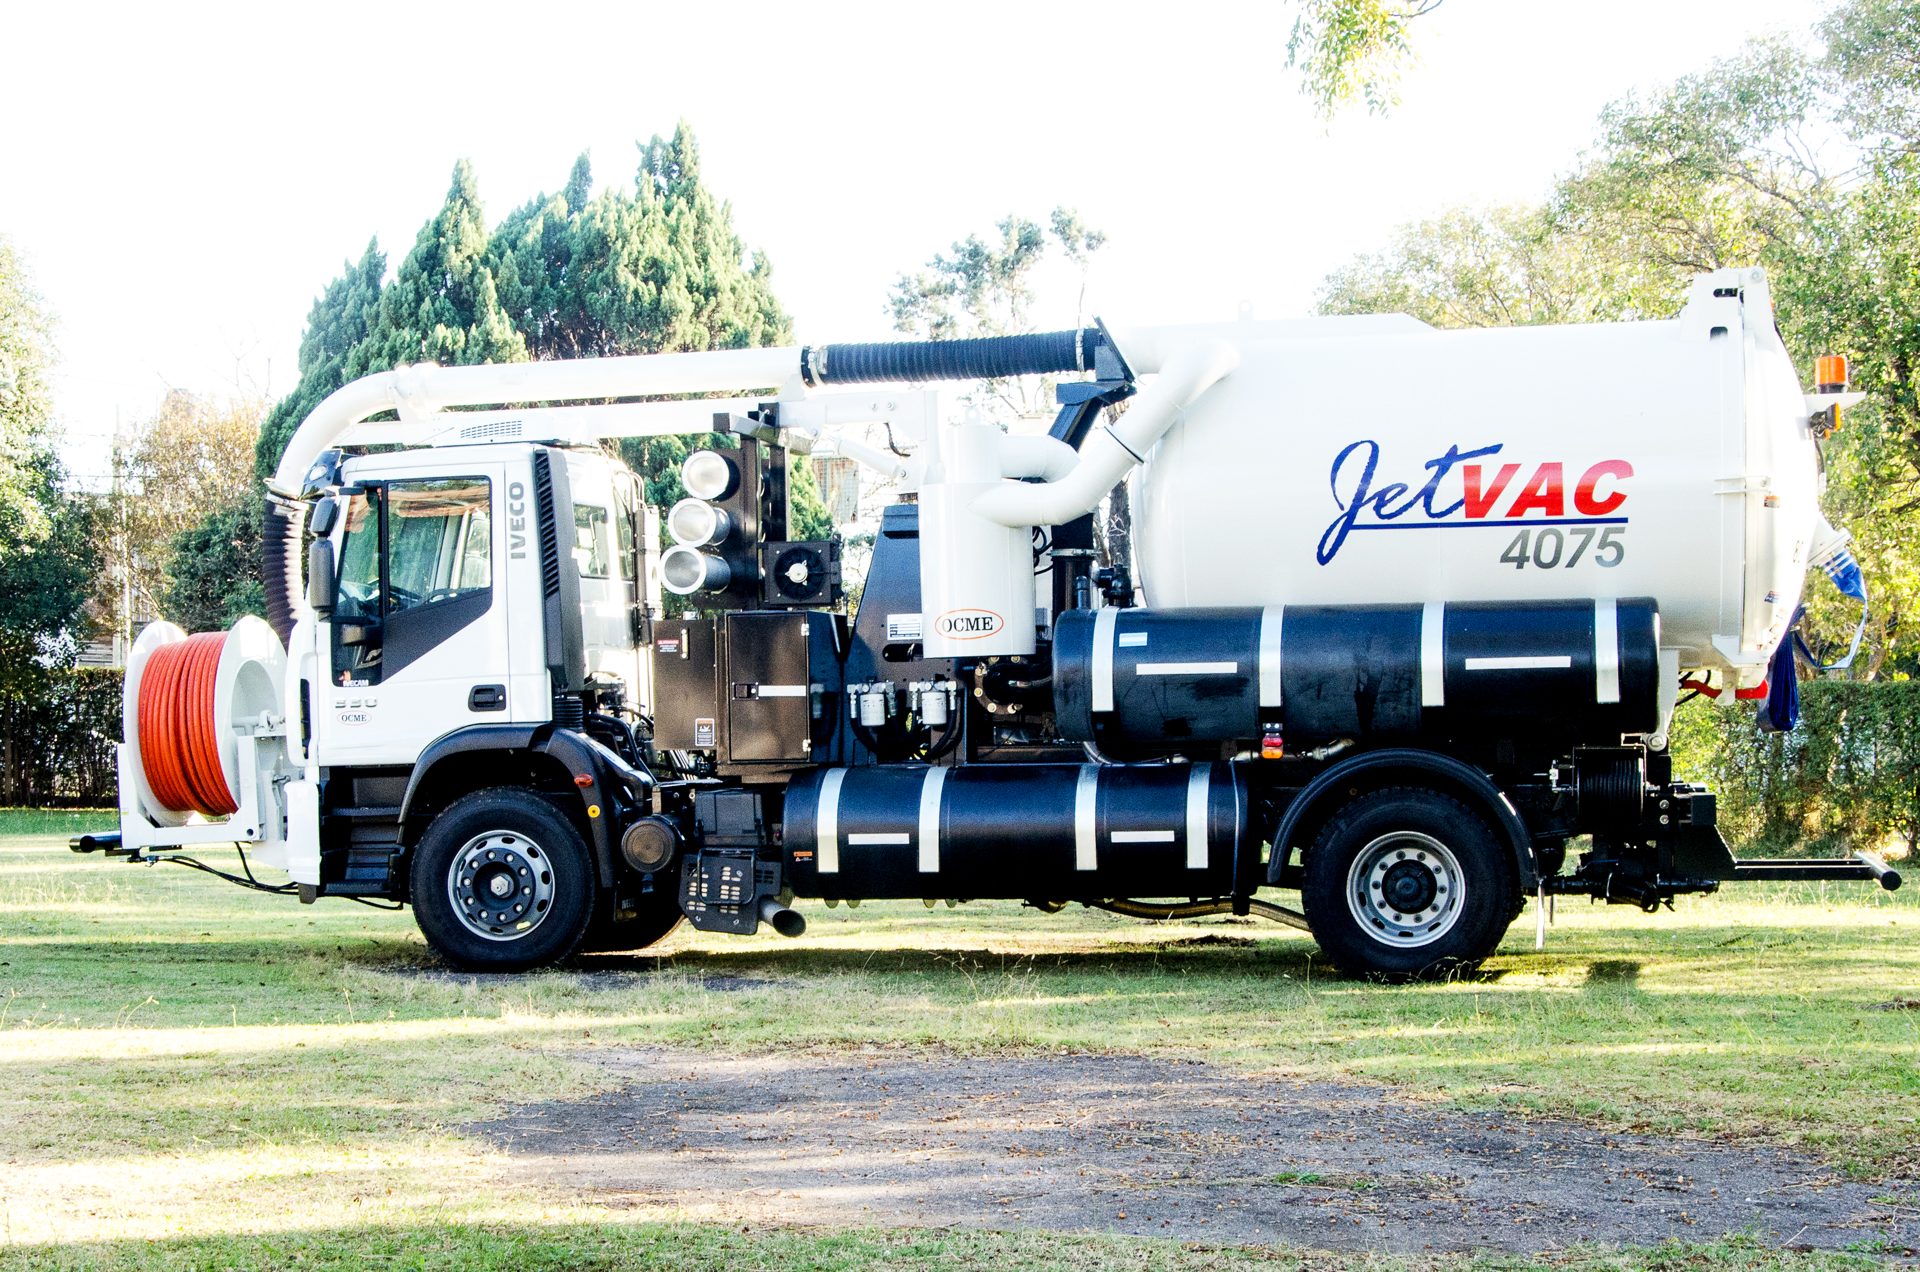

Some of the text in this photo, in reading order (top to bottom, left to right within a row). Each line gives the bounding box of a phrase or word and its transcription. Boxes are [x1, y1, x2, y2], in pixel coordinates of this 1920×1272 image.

[508, 481, 526, 560] IVECO
[1499, 526, 1626, 569] 4075
[942, 616, 993, 633] OCME
[341, 714, 367, 722] OCME
